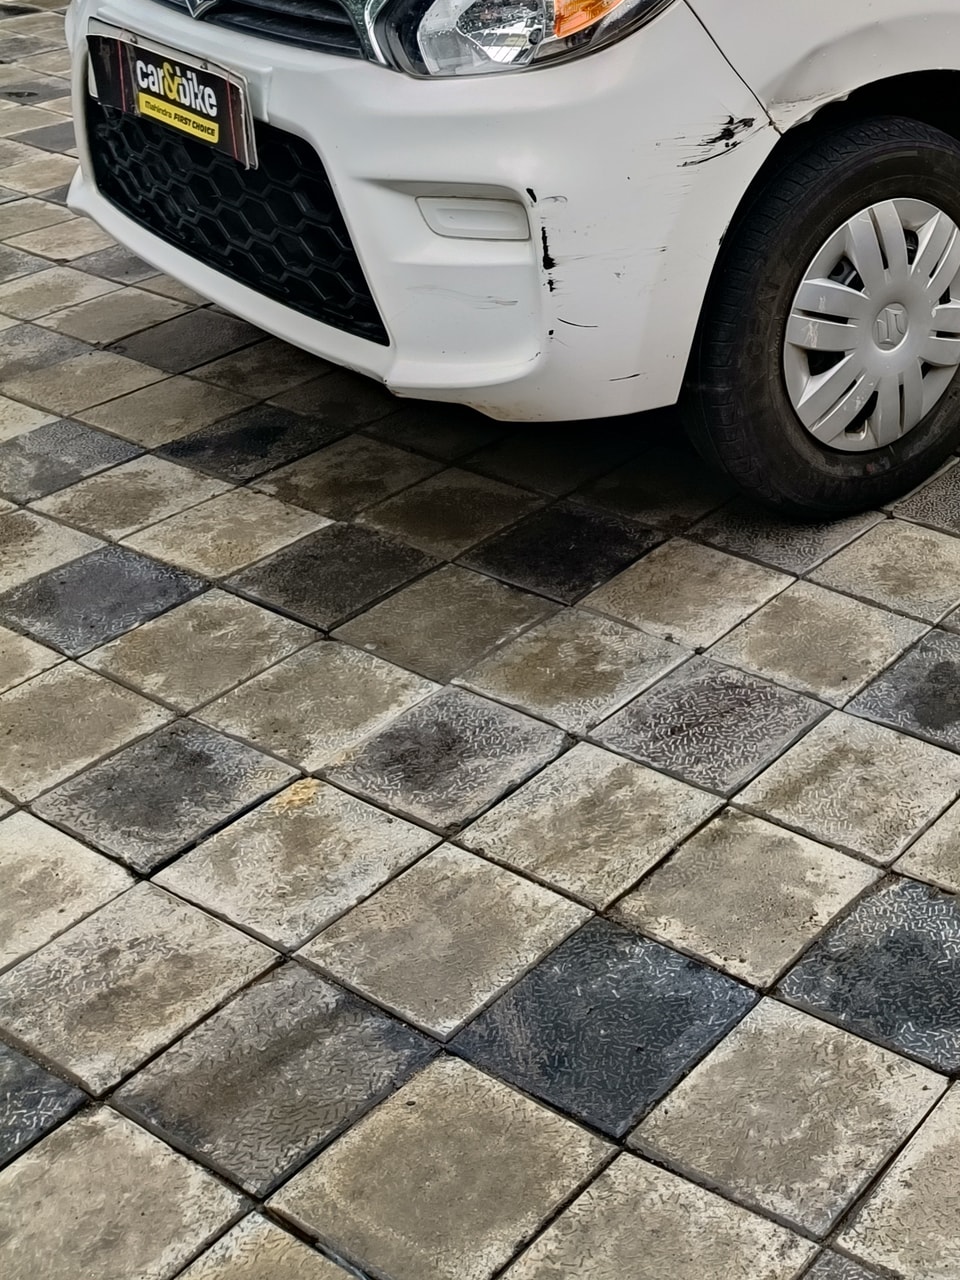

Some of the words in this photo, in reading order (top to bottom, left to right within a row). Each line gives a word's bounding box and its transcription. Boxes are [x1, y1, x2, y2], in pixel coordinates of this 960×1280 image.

[136, 60, 218, 117] car&bike
[173, 112, 193, 128] FIRST
[192, 120, 215, 136] CHOICE
